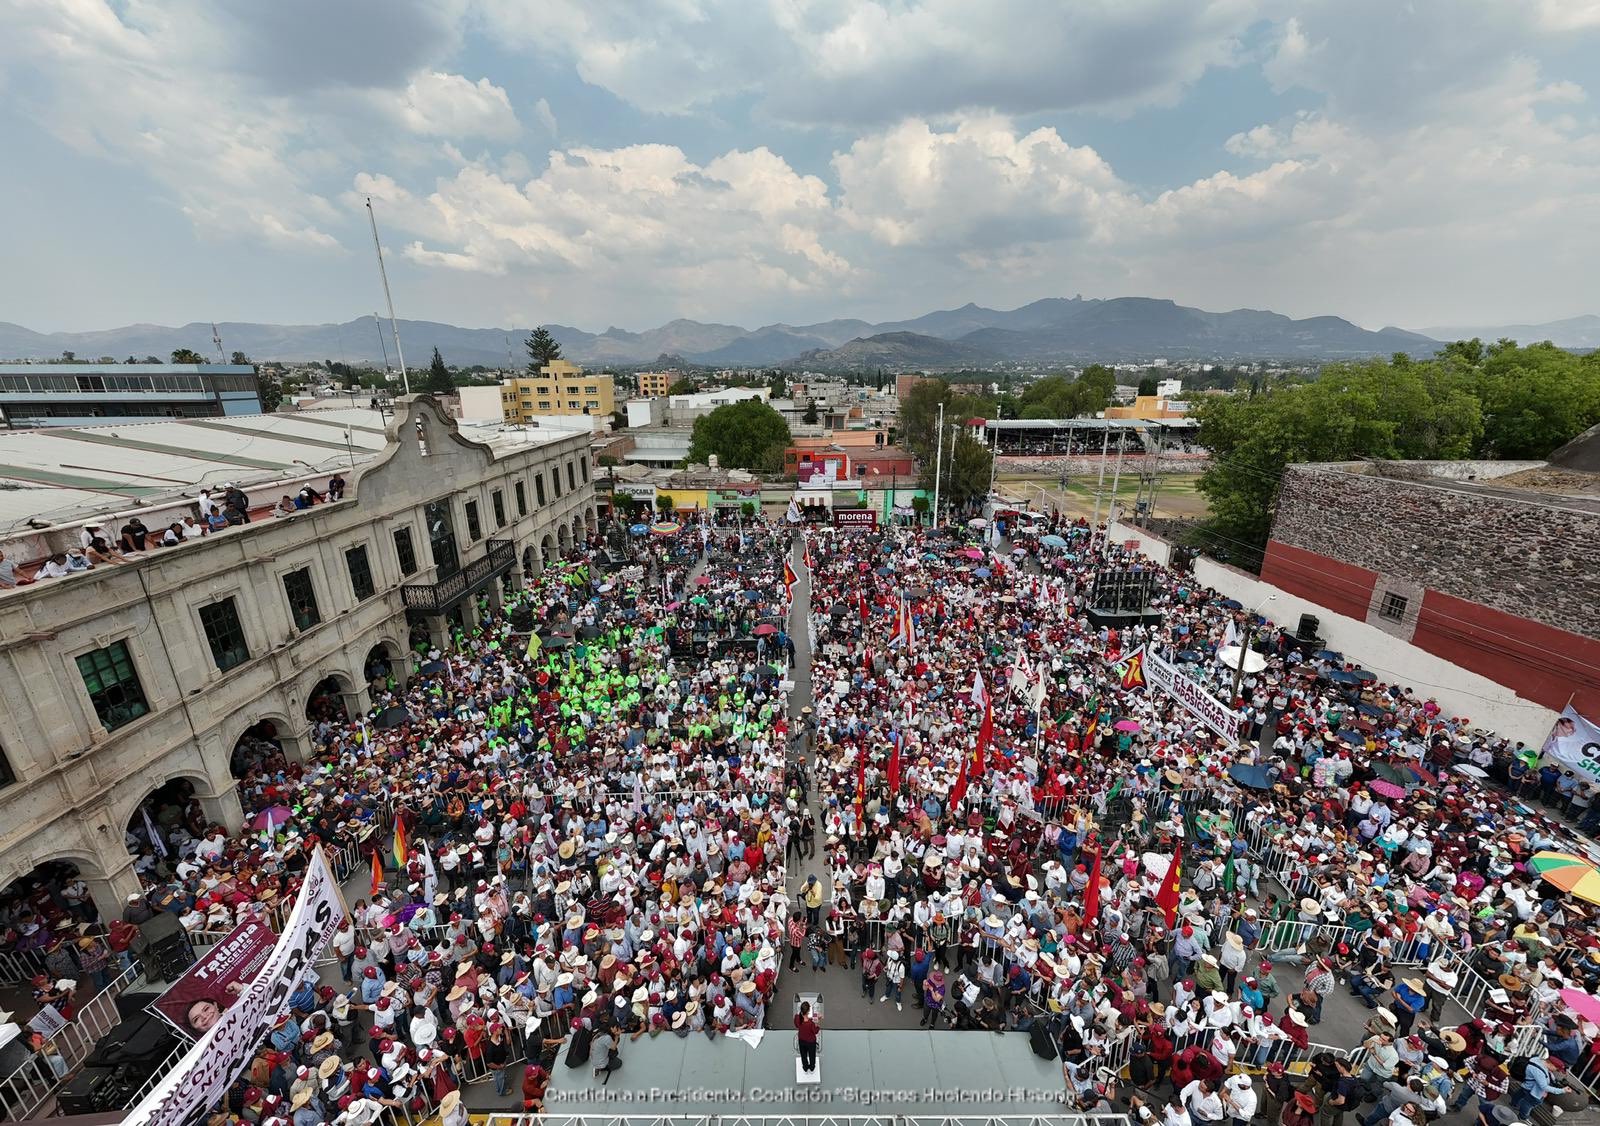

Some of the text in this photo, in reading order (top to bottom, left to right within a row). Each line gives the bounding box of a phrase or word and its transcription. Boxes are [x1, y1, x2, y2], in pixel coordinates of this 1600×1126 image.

[1172, 682, 1225, 730] IMPOSICIONES
[194, 923, 258, 980] Tatiana
[39, 1010, 60, 1029] morena
[227, 1030, 236, 1044] Y
